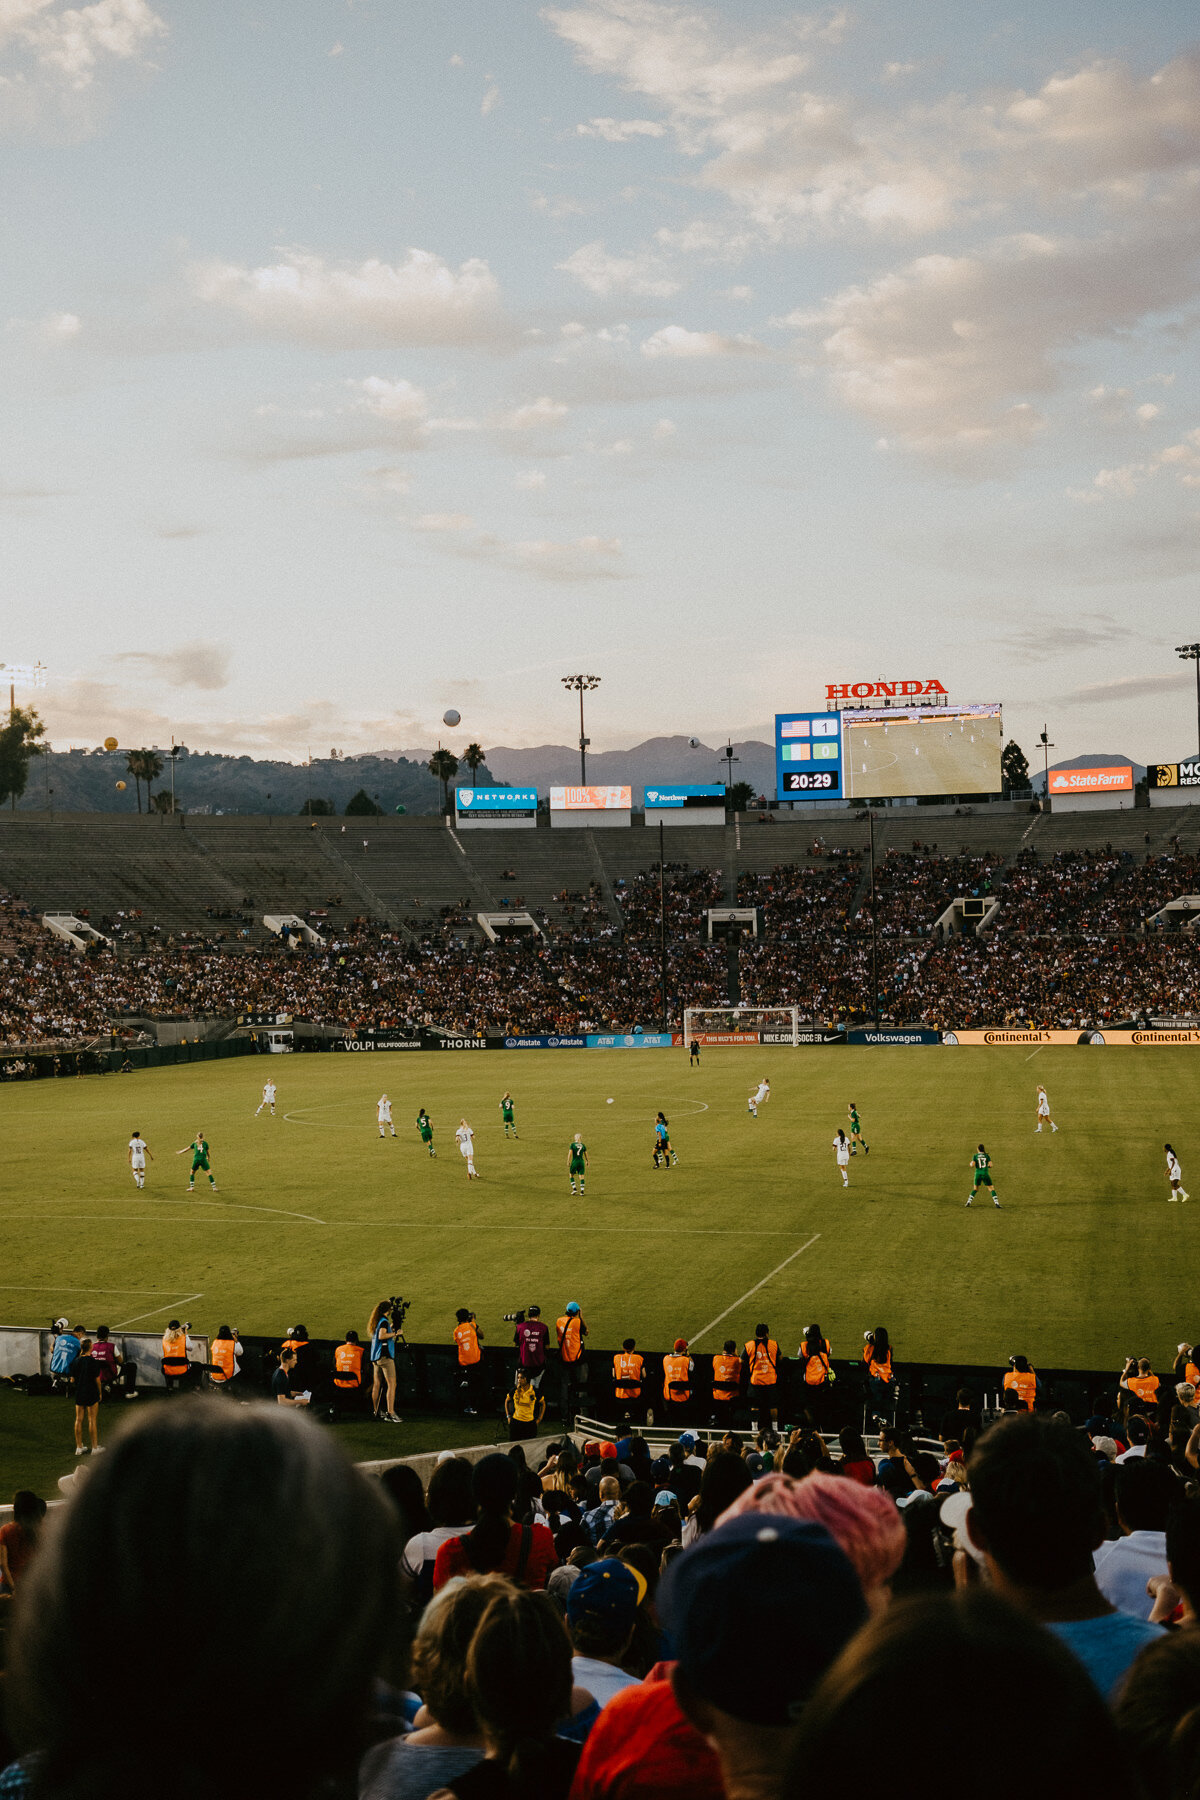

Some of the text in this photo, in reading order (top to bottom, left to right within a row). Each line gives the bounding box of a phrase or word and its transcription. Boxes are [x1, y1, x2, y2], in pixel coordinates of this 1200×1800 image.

[825, 679, 949, 700] HONDA
[821, 722, 828, 733] 1
[822, 745, 830, 758] 0
[790, 774, 832, 789] 20:29
[567, 788, 590, 803] 100%
[517, 1039, 541, 1047] Allstate
[559, 1038, 583, 1046] Allstate
[597, 1037, 615, 1046] AT&T
[643, 1036, 662, 1045] AT&T
[865, 1033, 922, 1044] Volkswagen
[983, 1031, 1042, 1044] Continental
[1131, 1031, 1191, 1044] Continental
[344, 1040, 421, 1051] VOLPI VOLPIFOODS.COM
[440, 1039, 487, 1048] THORNE
[505, 1101, 511, 1110] 9
[420, 1118, 427, 1127] 5
[200, 1144, 205, 1153] 4
[576, 1146, 583, 1156] 7
[978, 1157, 987, 1169] 13
